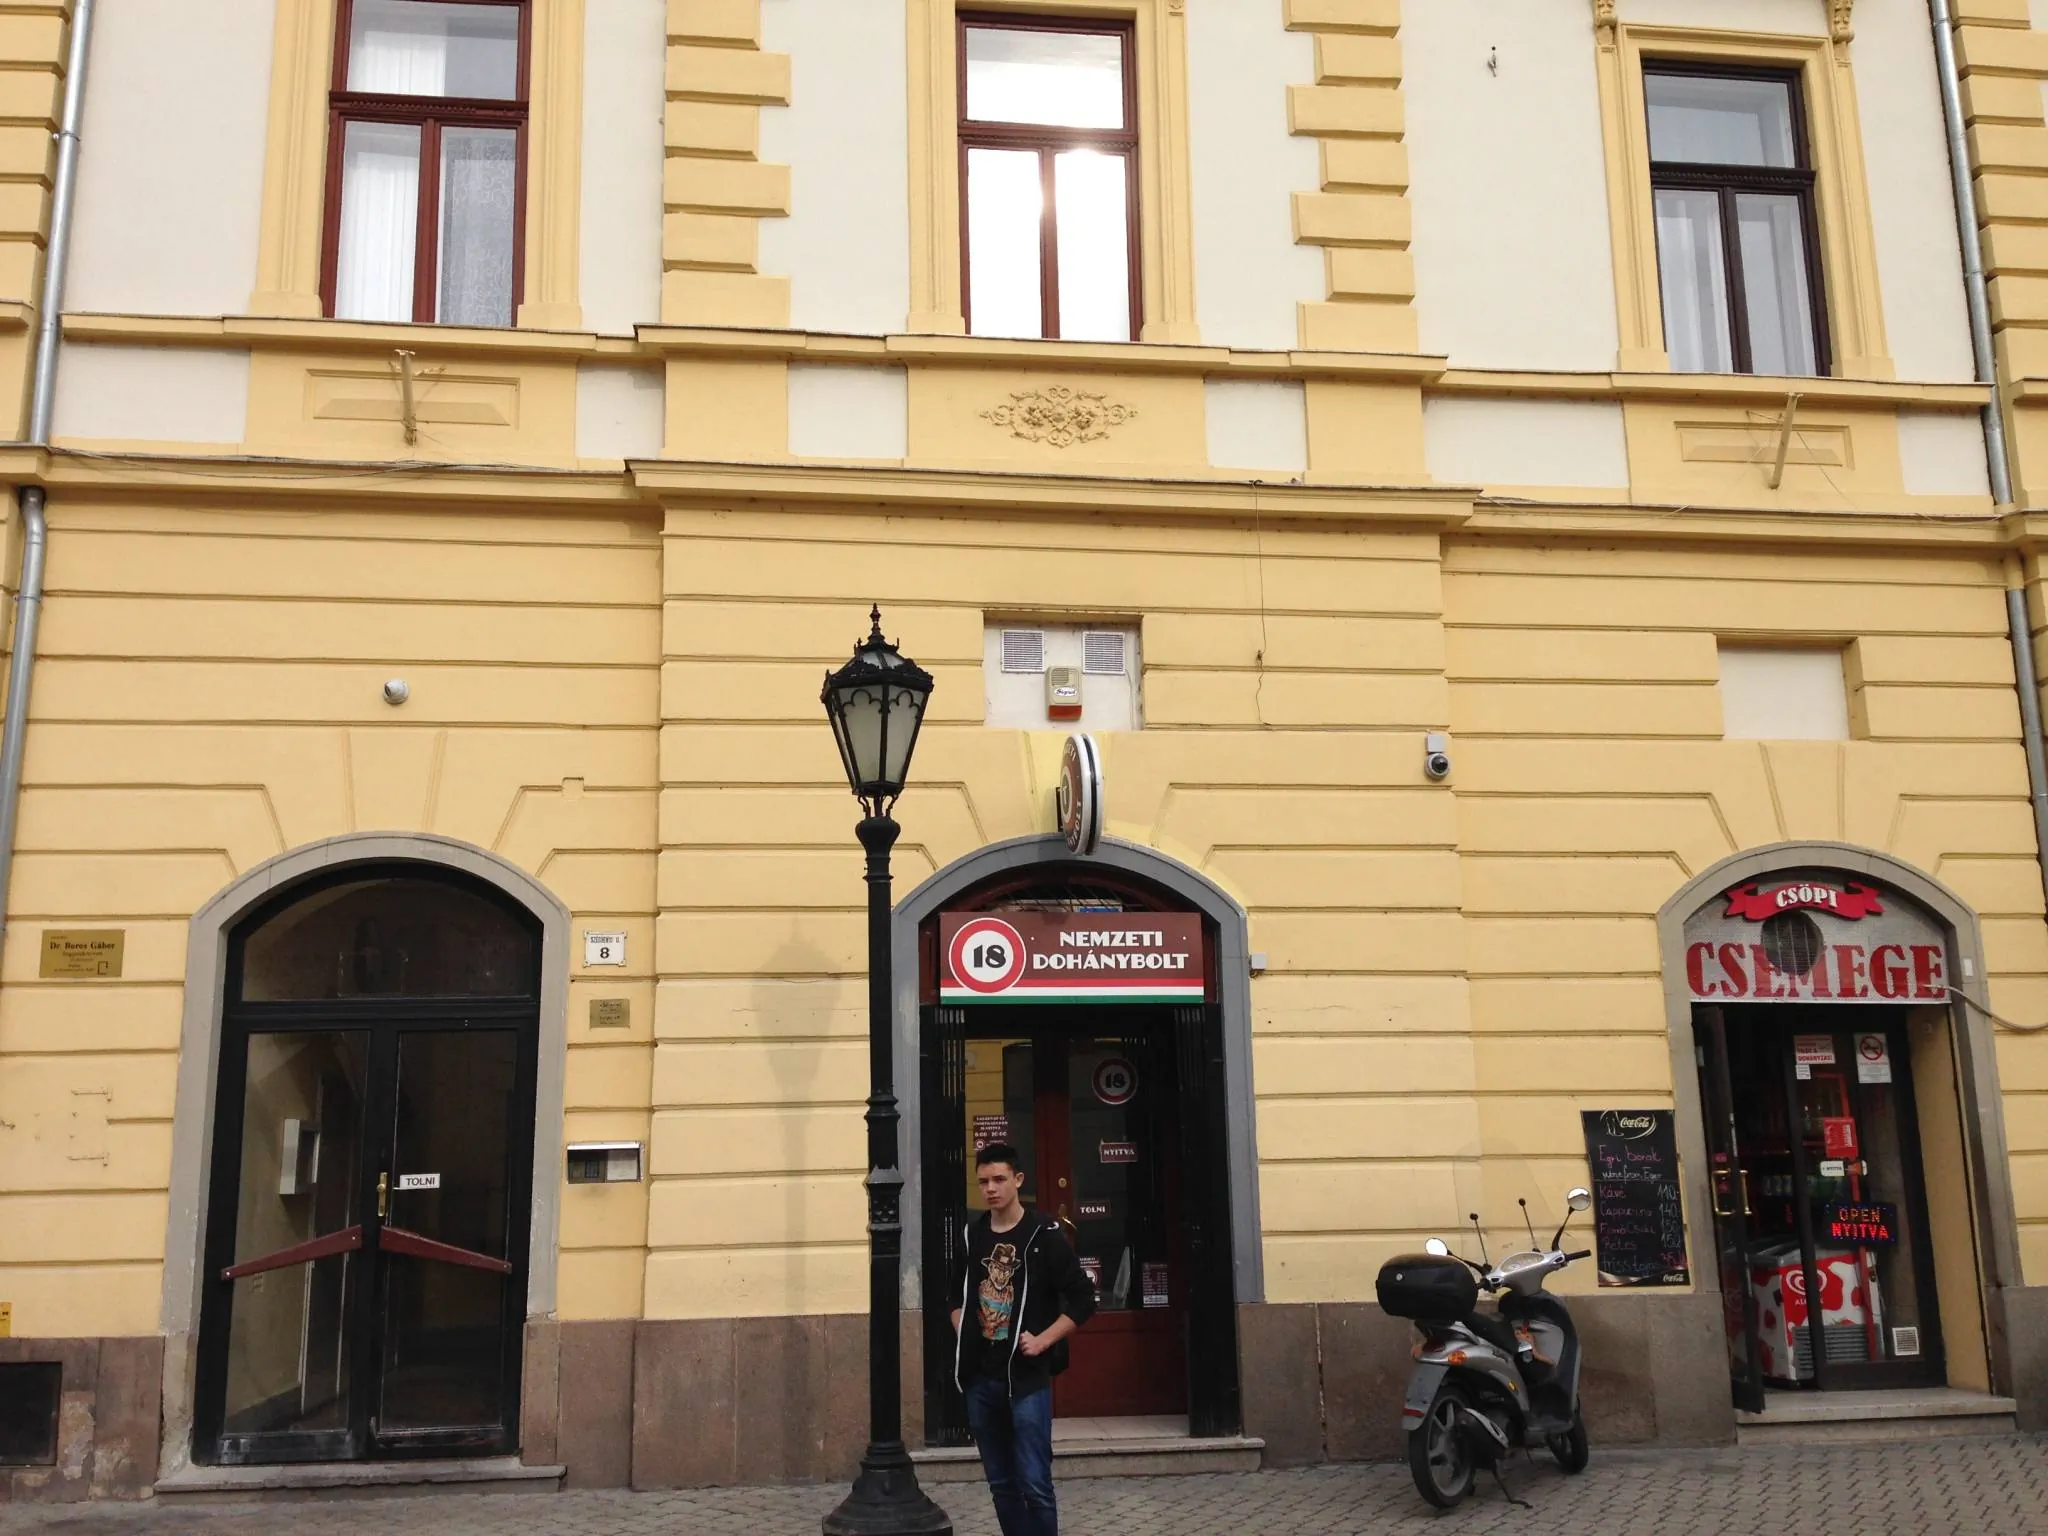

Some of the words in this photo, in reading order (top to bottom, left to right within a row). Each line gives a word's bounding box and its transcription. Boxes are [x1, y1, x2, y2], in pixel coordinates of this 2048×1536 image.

[1776, 884, 1838, 908] CSÖPI
[1060, 931, 1163, 947] NEMZETI
[600, 947, 610, 959] 8
[973, 944, 1006, 968] 18
[1032, 950, 1189, 970] DOHÁNYBOLT
[1105, 1073, 1126, 1089] 18
[1104, 1148, 1135, 1156] NYITVA
[405, 1177, 435, 1186] TOLNI
[1080, 1206, 1105, 1214] TOLNI
[1840, 1207, 1880, 1223] OPEN
[1832, 1223, 1888, 1239] NYITVA
